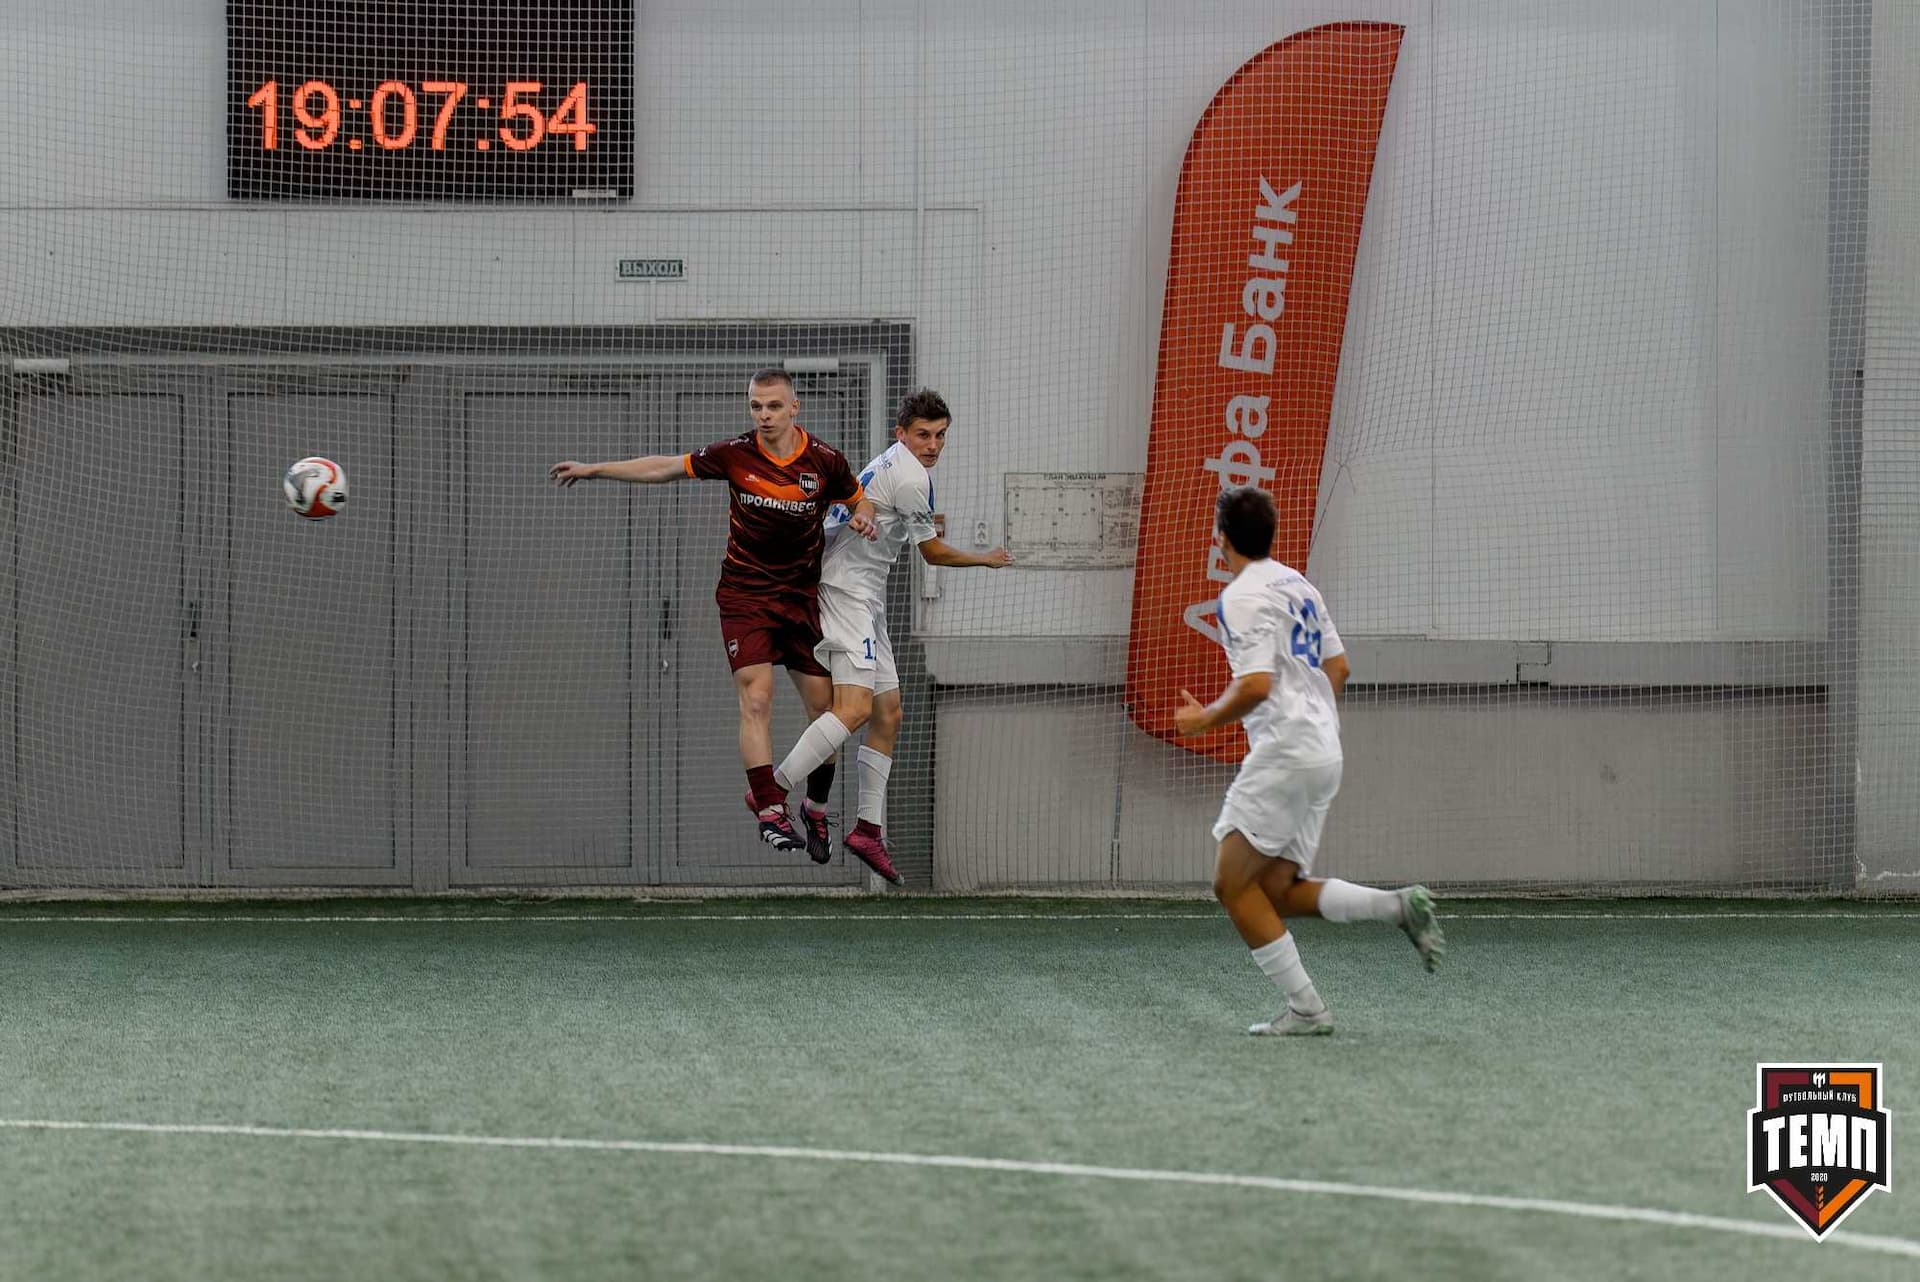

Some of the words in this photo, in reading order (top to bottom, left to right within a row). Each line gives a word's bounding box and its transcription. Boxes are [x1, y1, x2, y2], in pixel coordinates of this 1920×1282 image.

[248, 80, 596, 150] 19:07:54
[622, 261, 681, 276] ВЫХОД
[1218, 174, 1302, 375] Банк
[1183, 395, 1276, 648] Афа
